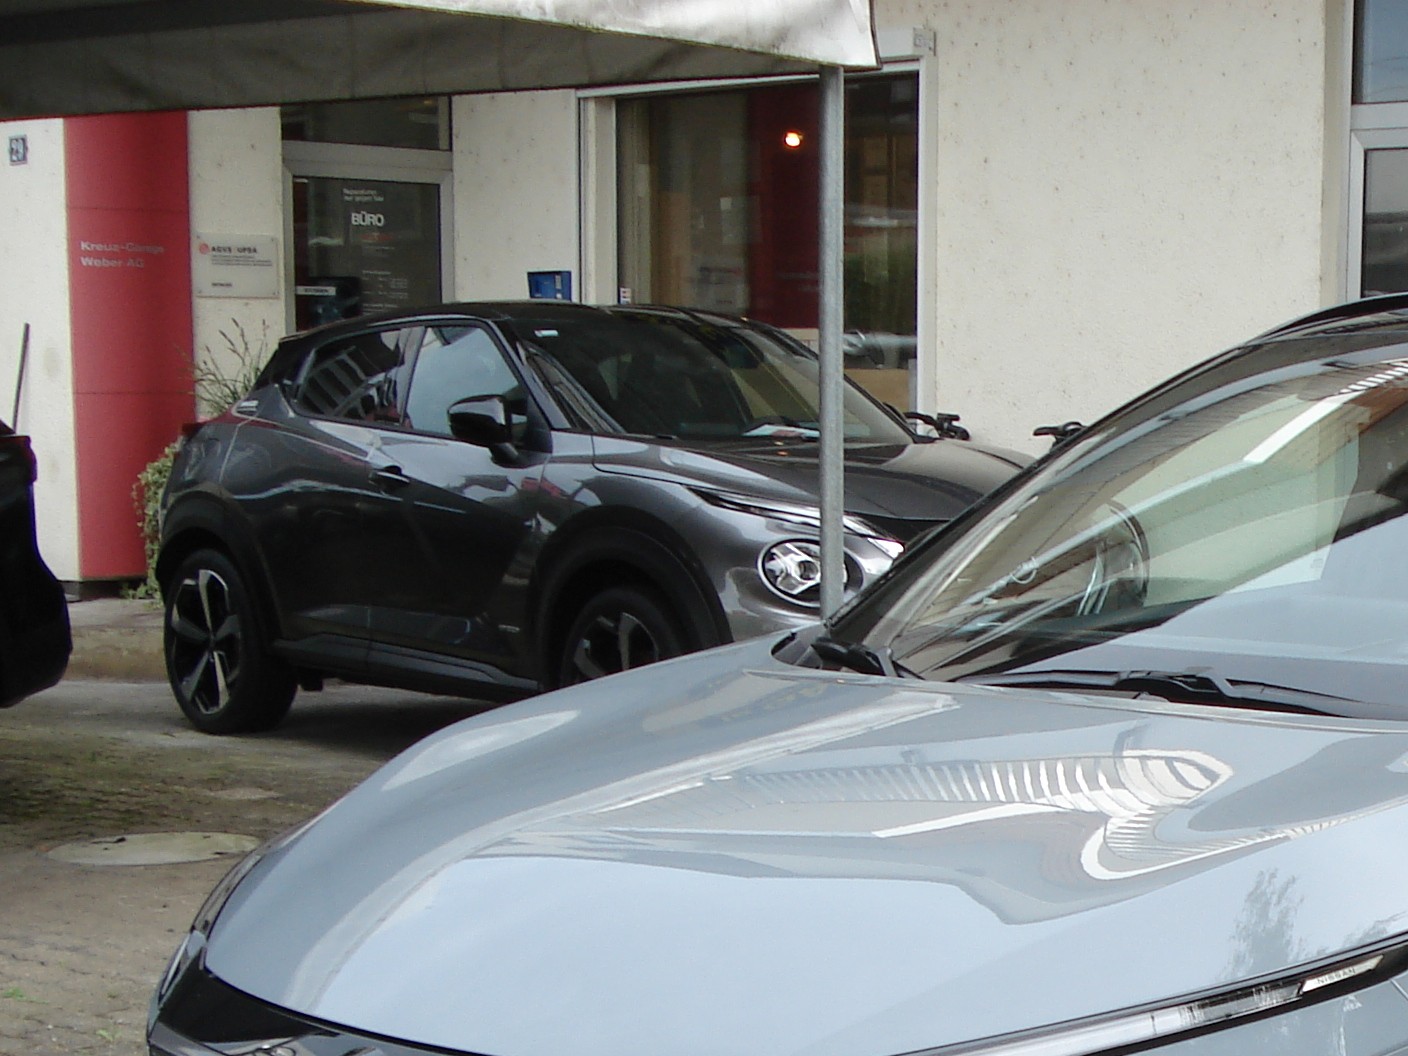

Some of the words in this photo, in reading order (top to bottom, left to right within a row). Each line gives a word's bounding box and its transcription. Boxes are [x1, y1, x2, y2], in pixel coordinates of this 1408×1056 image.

[351, 211, 384, 227] BÜRO
[80, 257, 122, 268] Weber
[127, 258, 145, 268] AG
